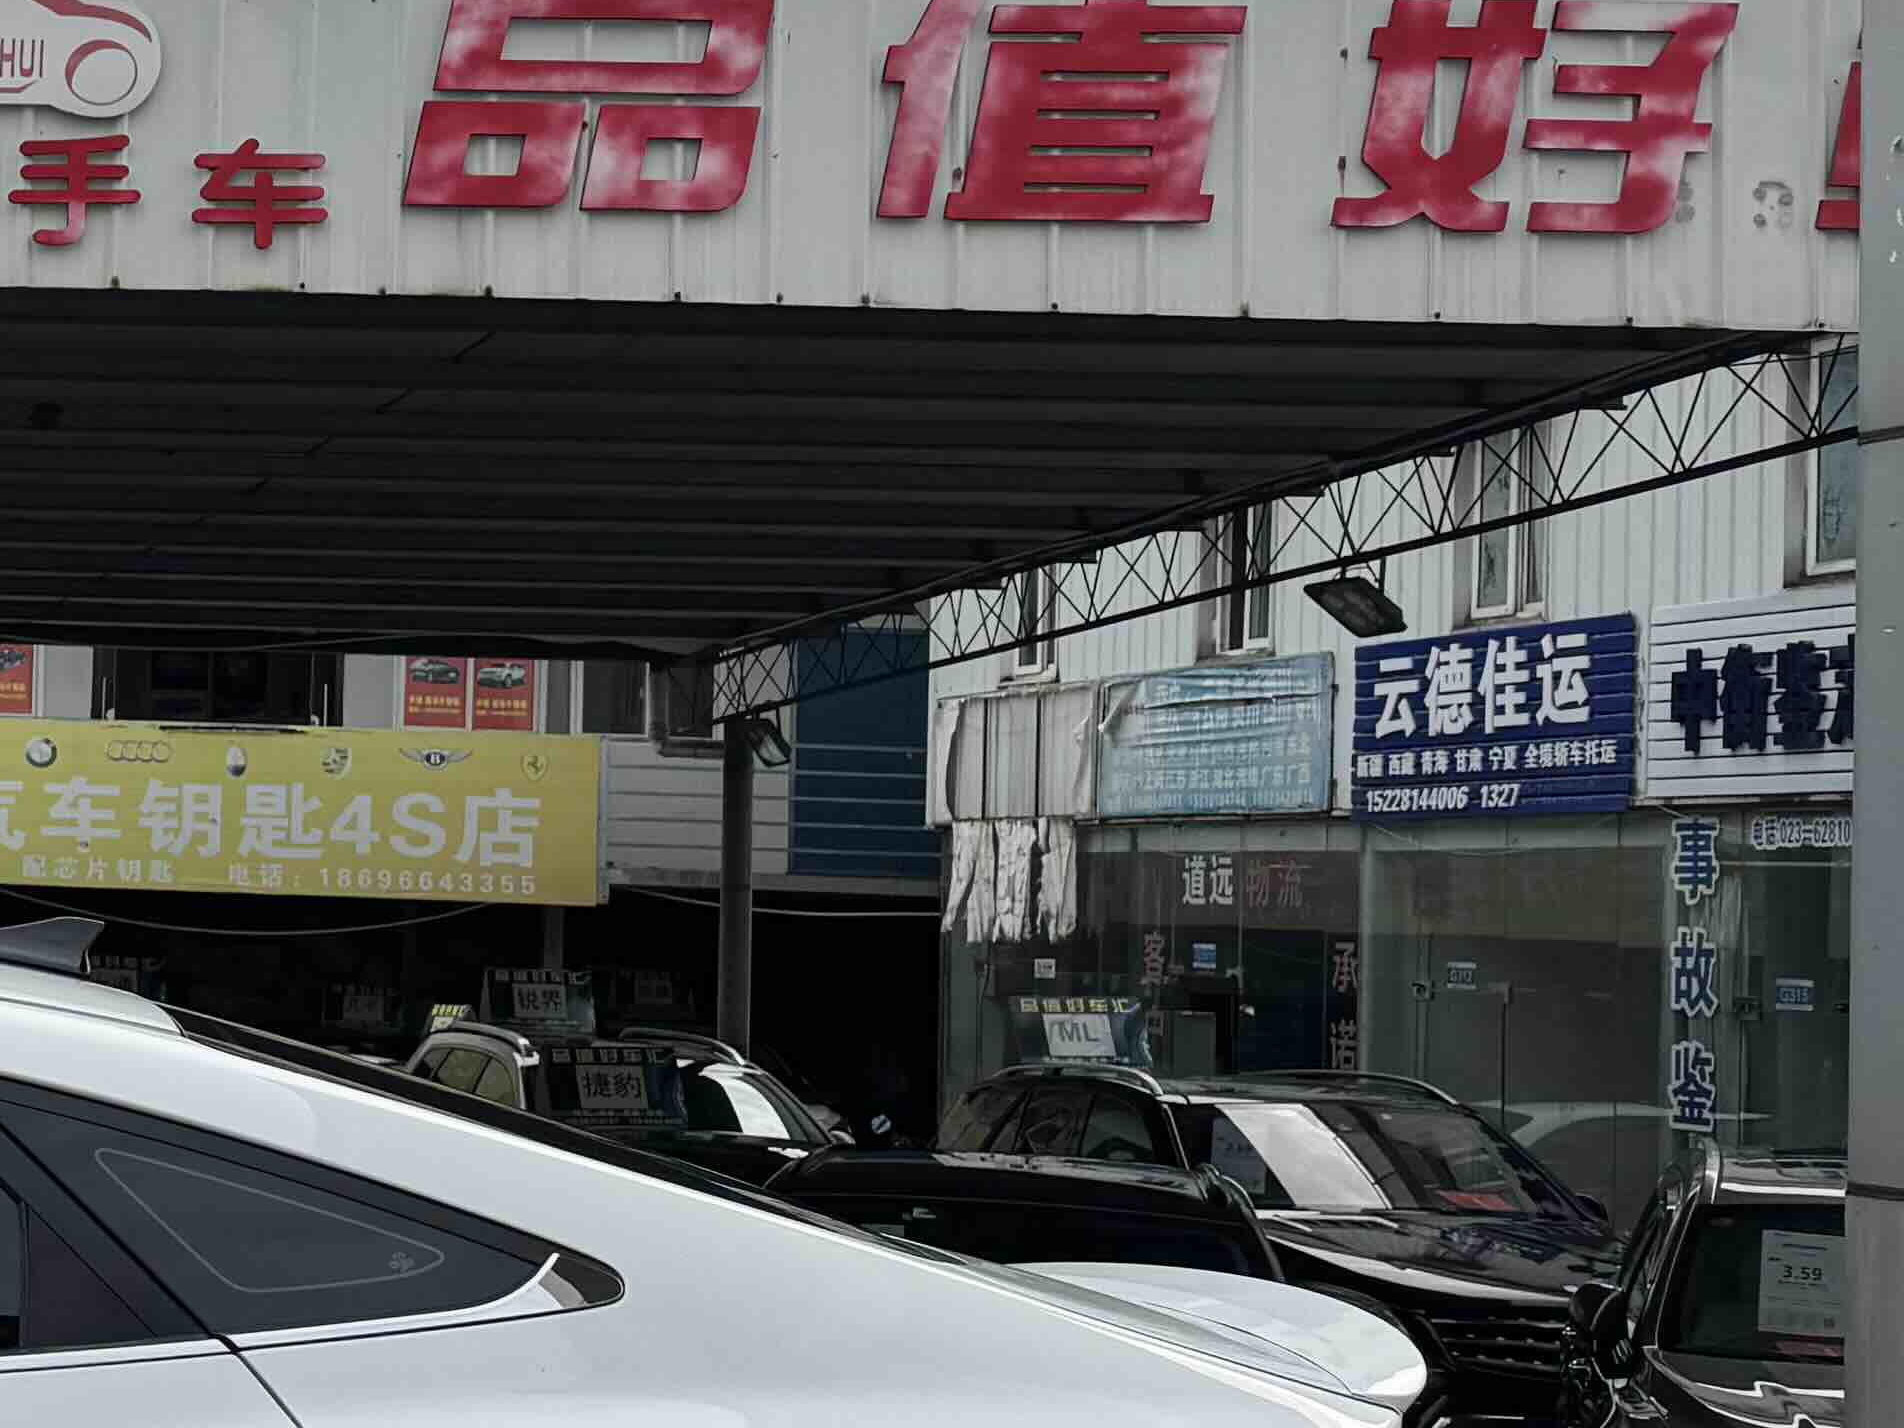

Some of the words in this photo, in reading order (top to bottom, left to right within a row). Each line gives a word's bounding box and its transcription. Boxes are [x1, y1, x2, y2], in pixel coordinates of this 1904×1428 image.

[1374, 633, 1590, 739] 云德佳运
[1367, 786, 1469, 812] 15228144006
[1669, 818, 1719, 1132] 事故鉴
[583, 1071, 640, 1099] 捷豹
[1781, 1264, 1824, 1282] 3.59
